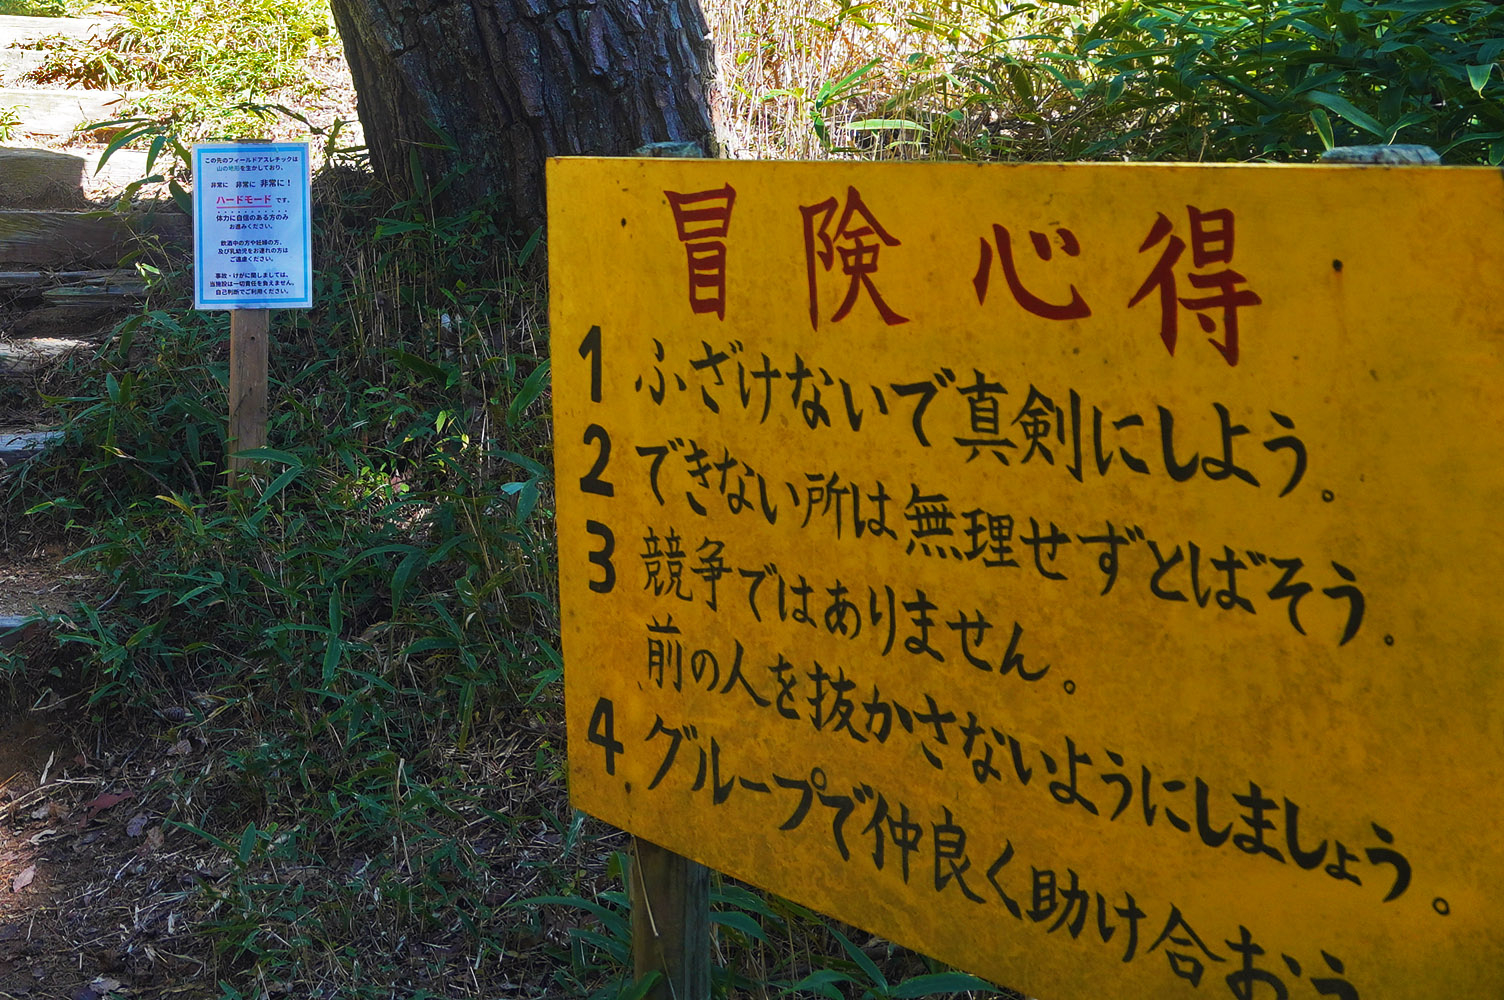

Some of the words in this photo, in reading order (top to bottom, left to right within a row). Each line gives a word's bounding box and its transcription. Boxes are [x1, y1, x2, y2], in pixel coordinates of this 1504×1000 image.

[205, 156, 298, 164] この先のフィールドアスレチックは
[216, 195, 272, 204] ハードモード
[216, 214, 289, 222] 体力に自信のある方のみ
[663, 183, 1262, 367] 冒険心得
[578, 325, 602, 403] 1
[634, 338, 1335, 503] ふざけないで真剣にしよう。
[579, 423, 615, 497] 2
[634, 437, 1395, 647] できない所は無理せずとばそう。
[585, 519, 616, 593] 3
[641, 526, 1077, 695] 競争ではありません。
[646, 614, 1451, 917] 前の人を抜かさないようにしましょう。
